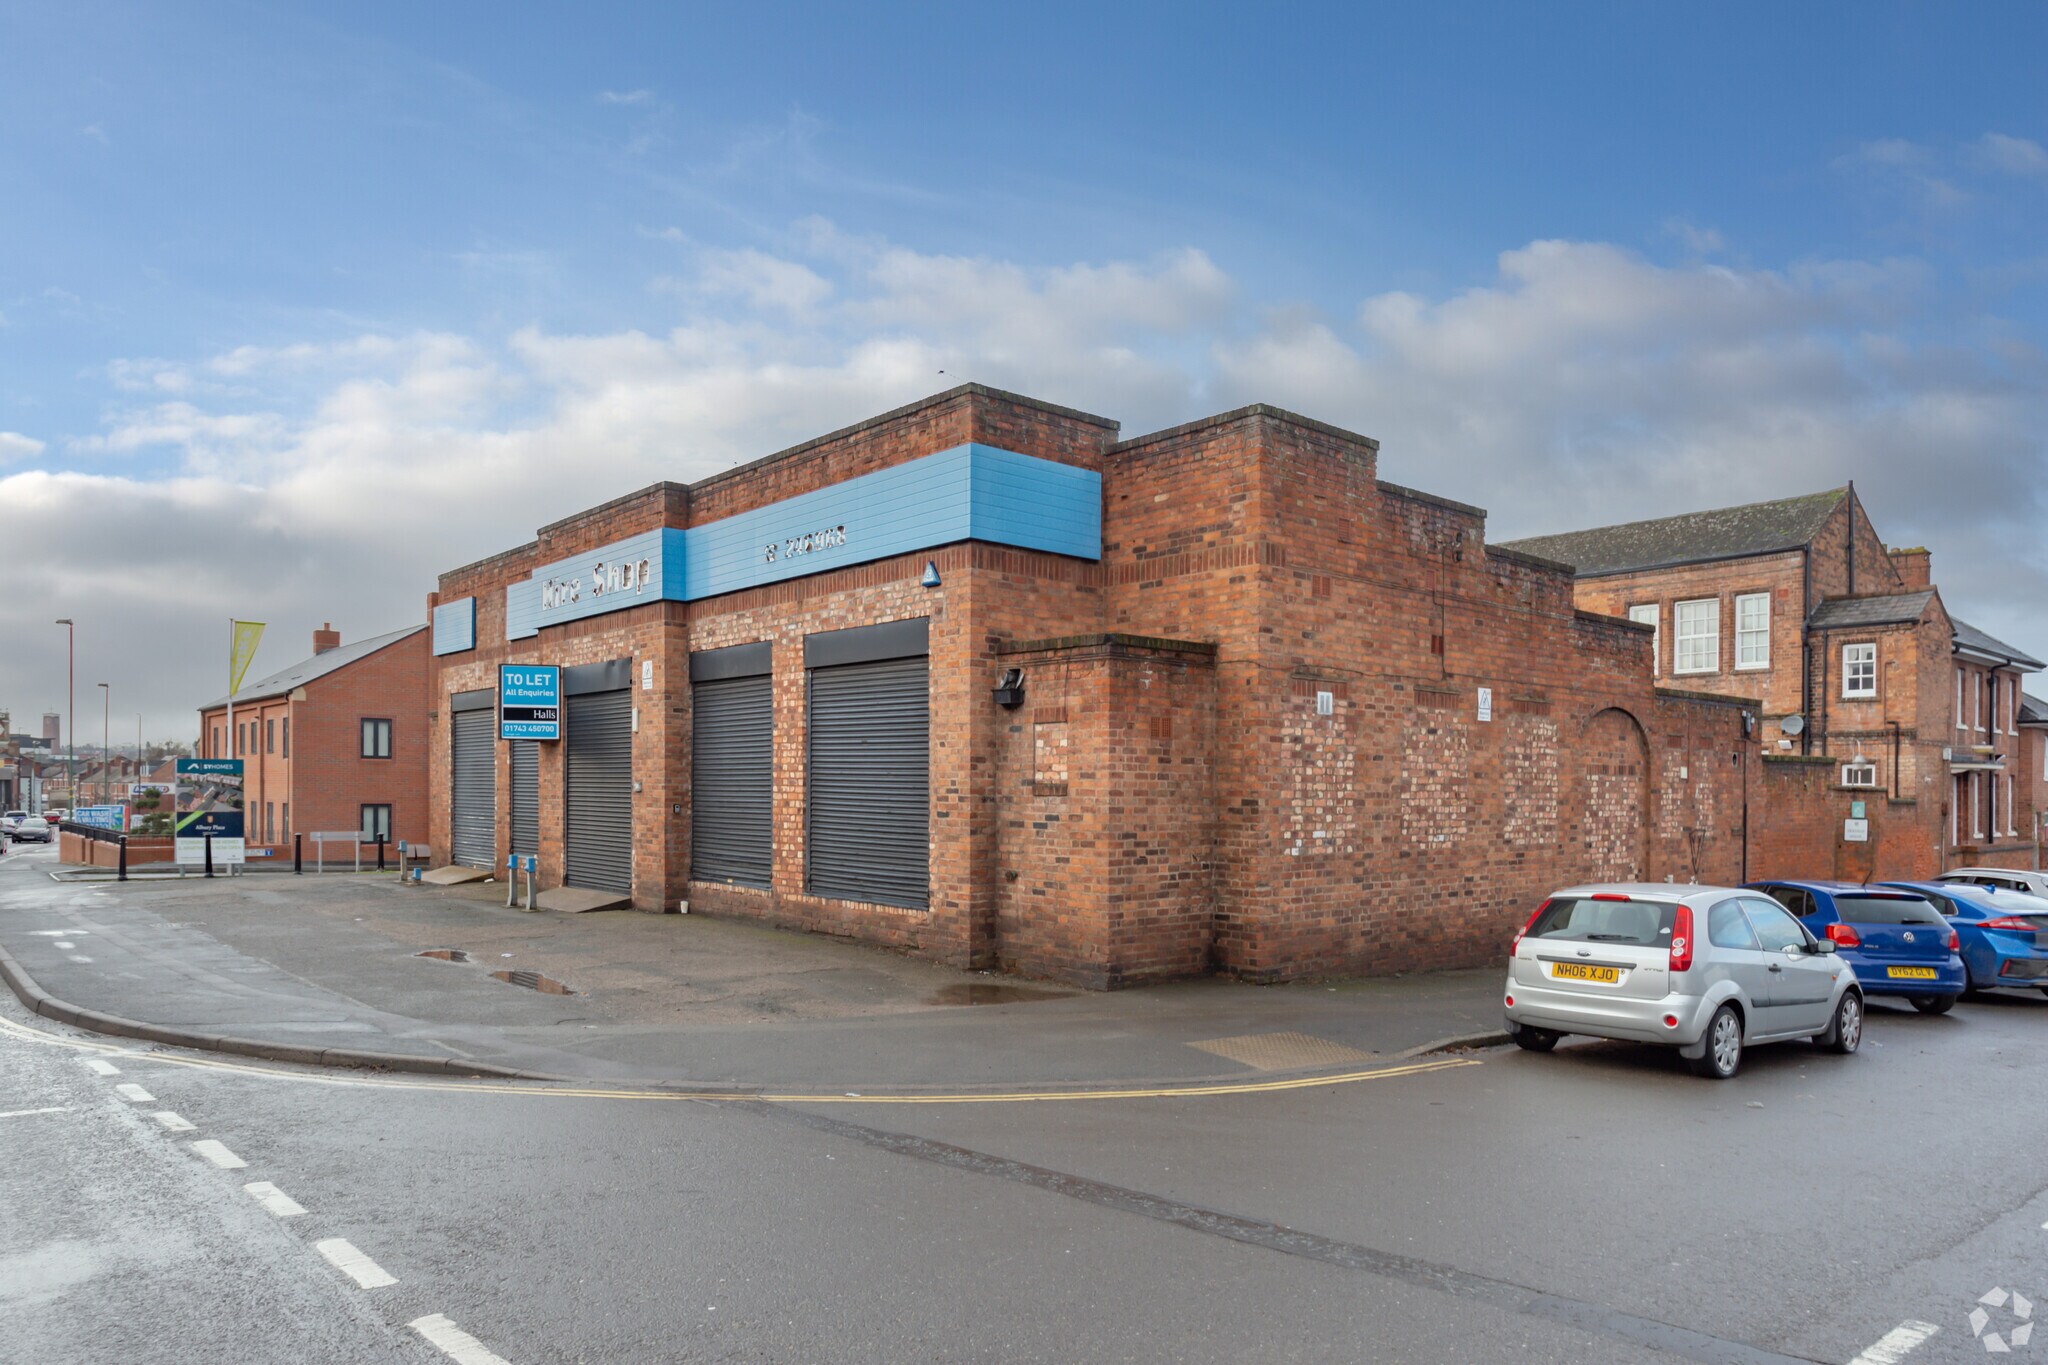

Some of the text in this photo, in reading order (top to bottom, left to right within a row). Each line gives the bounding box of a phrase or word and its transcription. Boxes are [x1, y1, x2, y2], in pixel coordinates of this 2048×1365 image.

[593, 558, 649, 597] Shop
[505, 673, 551, 686] TO LET
[505, 688, 554, 698] All Enquiries
[533, 709, 556, 719] Halls
[504, 724, 554, 733] 01743 450700
[1556, 964, 1613, 980] NH06 XJO
[1890, 967, 1932, 977] DY62 GLV
